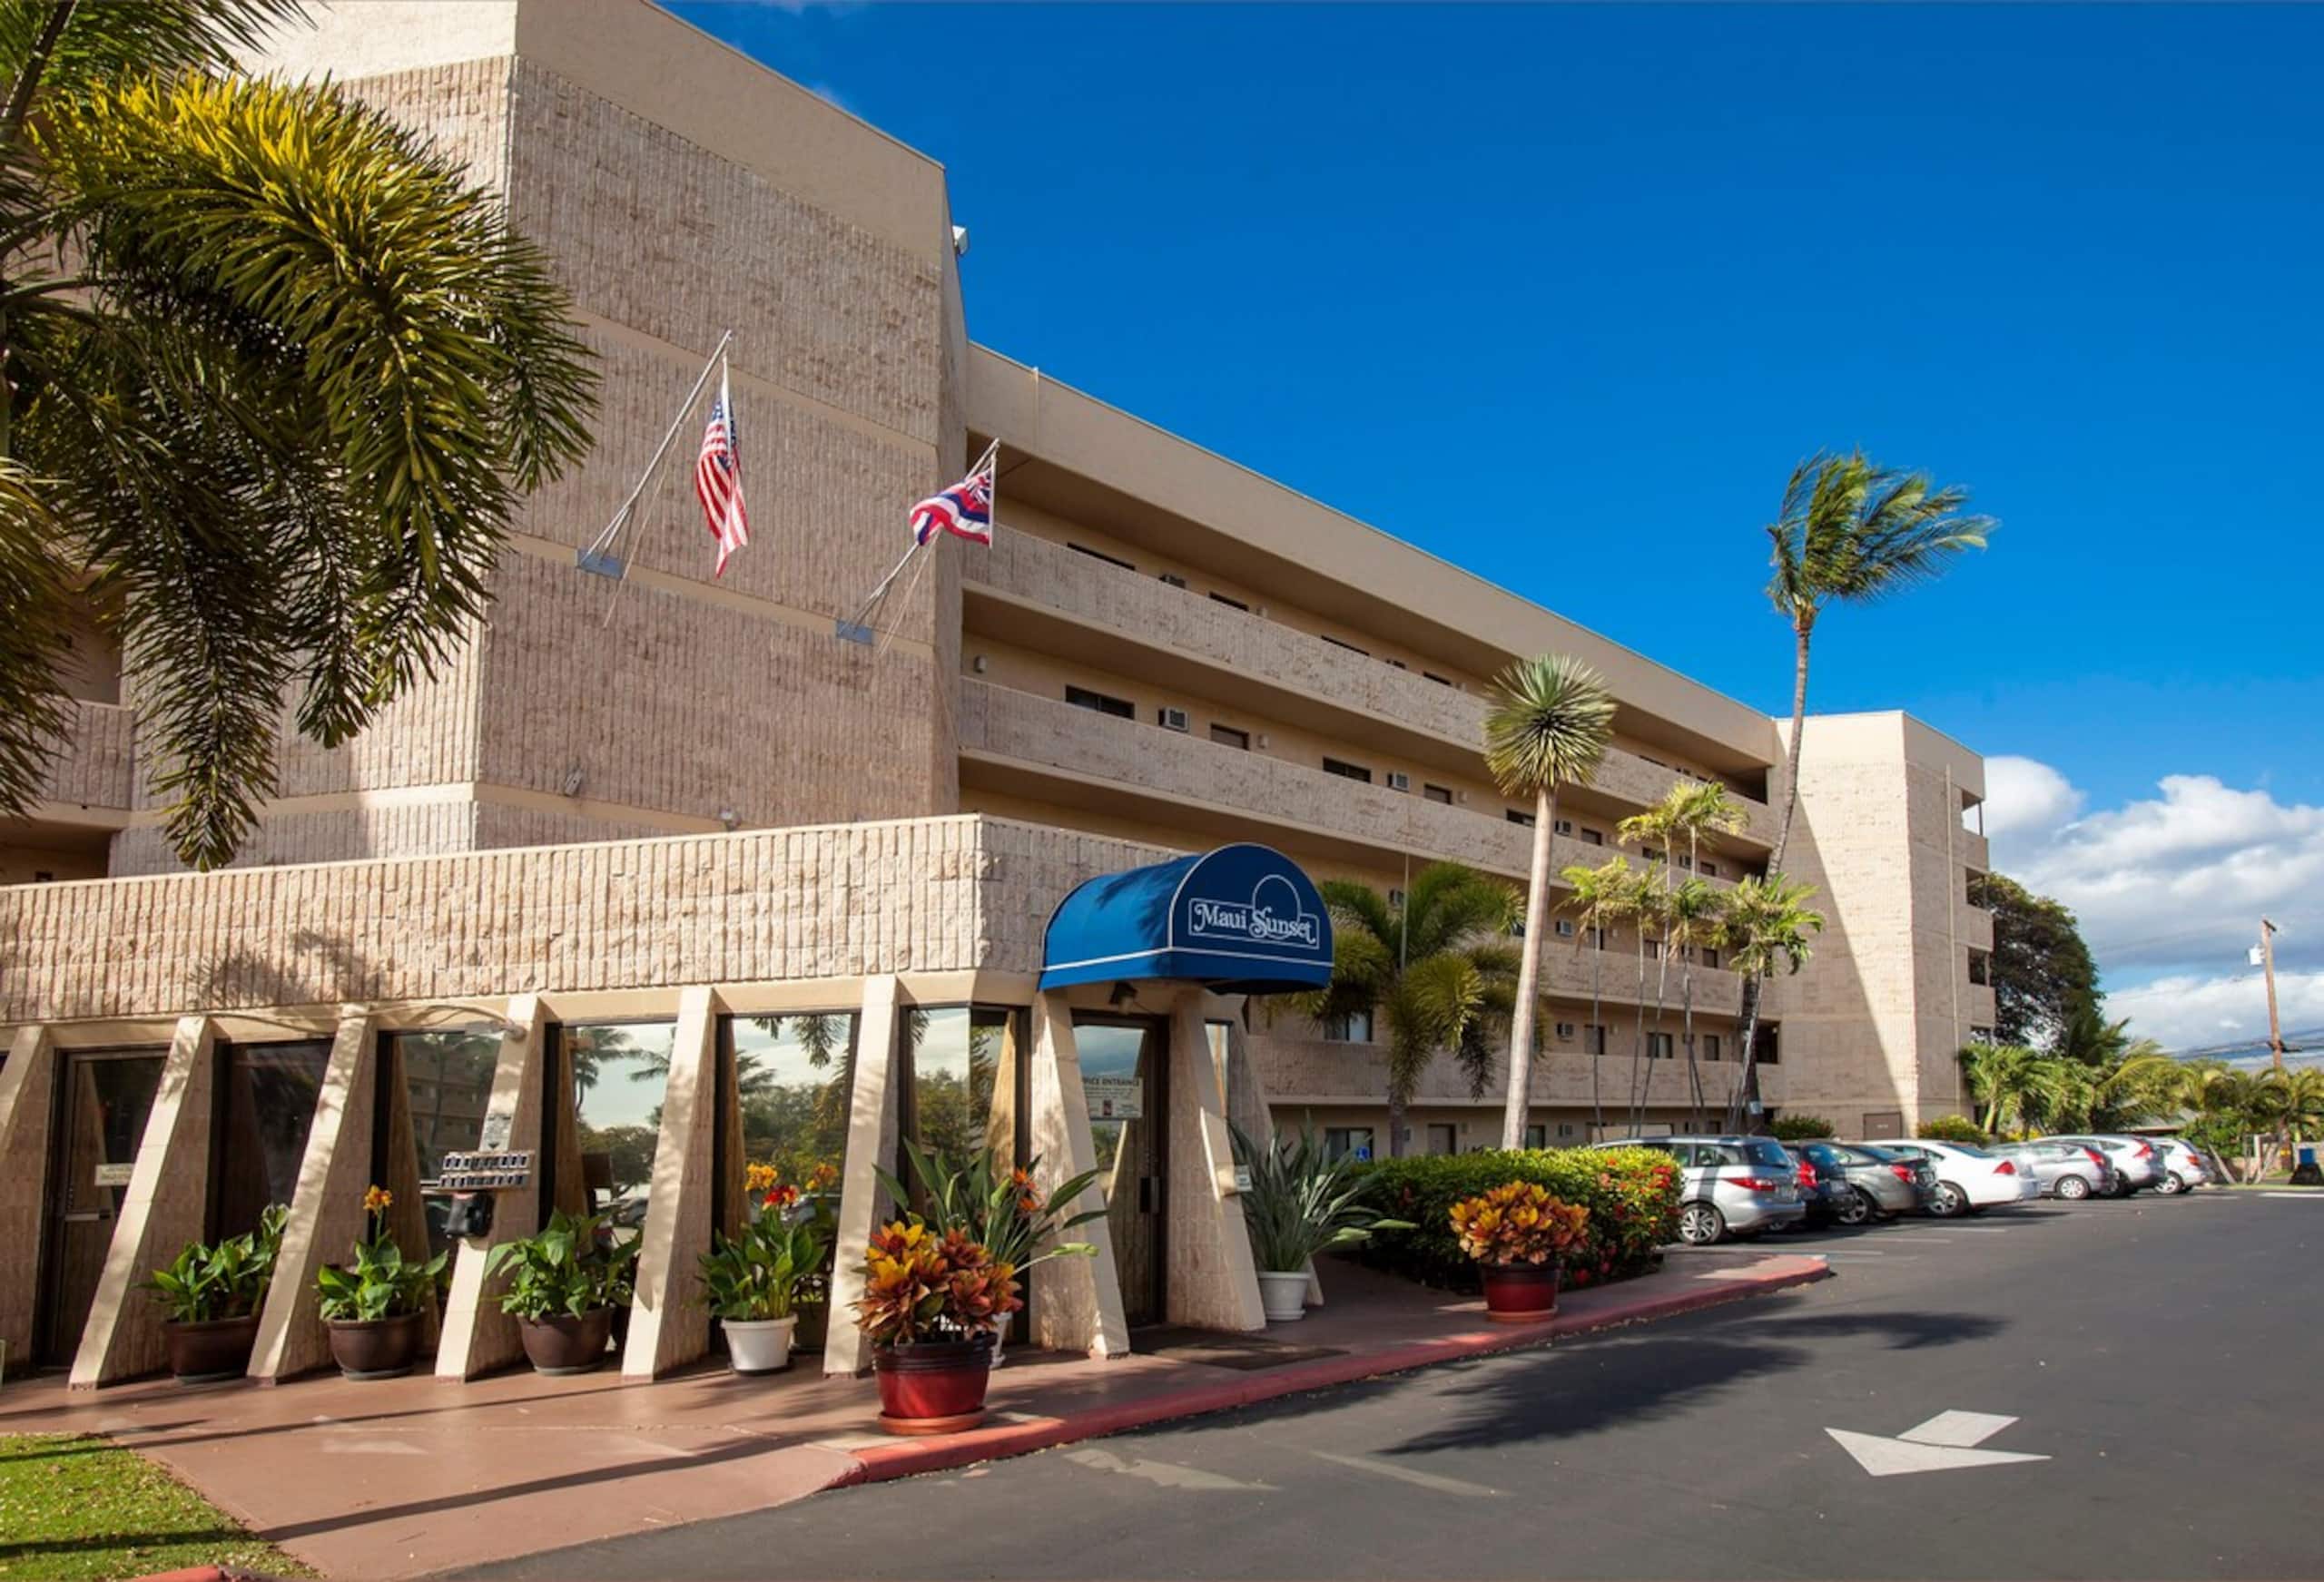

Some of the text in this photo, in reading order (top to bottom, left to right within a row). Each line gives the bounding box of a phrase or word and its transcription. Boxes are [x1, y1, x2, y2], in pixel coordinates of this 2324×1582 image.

[1193, 903, 1315, 945] Maui Sunset
[1102, 1077, 1140, 1087] ENTRANCE
